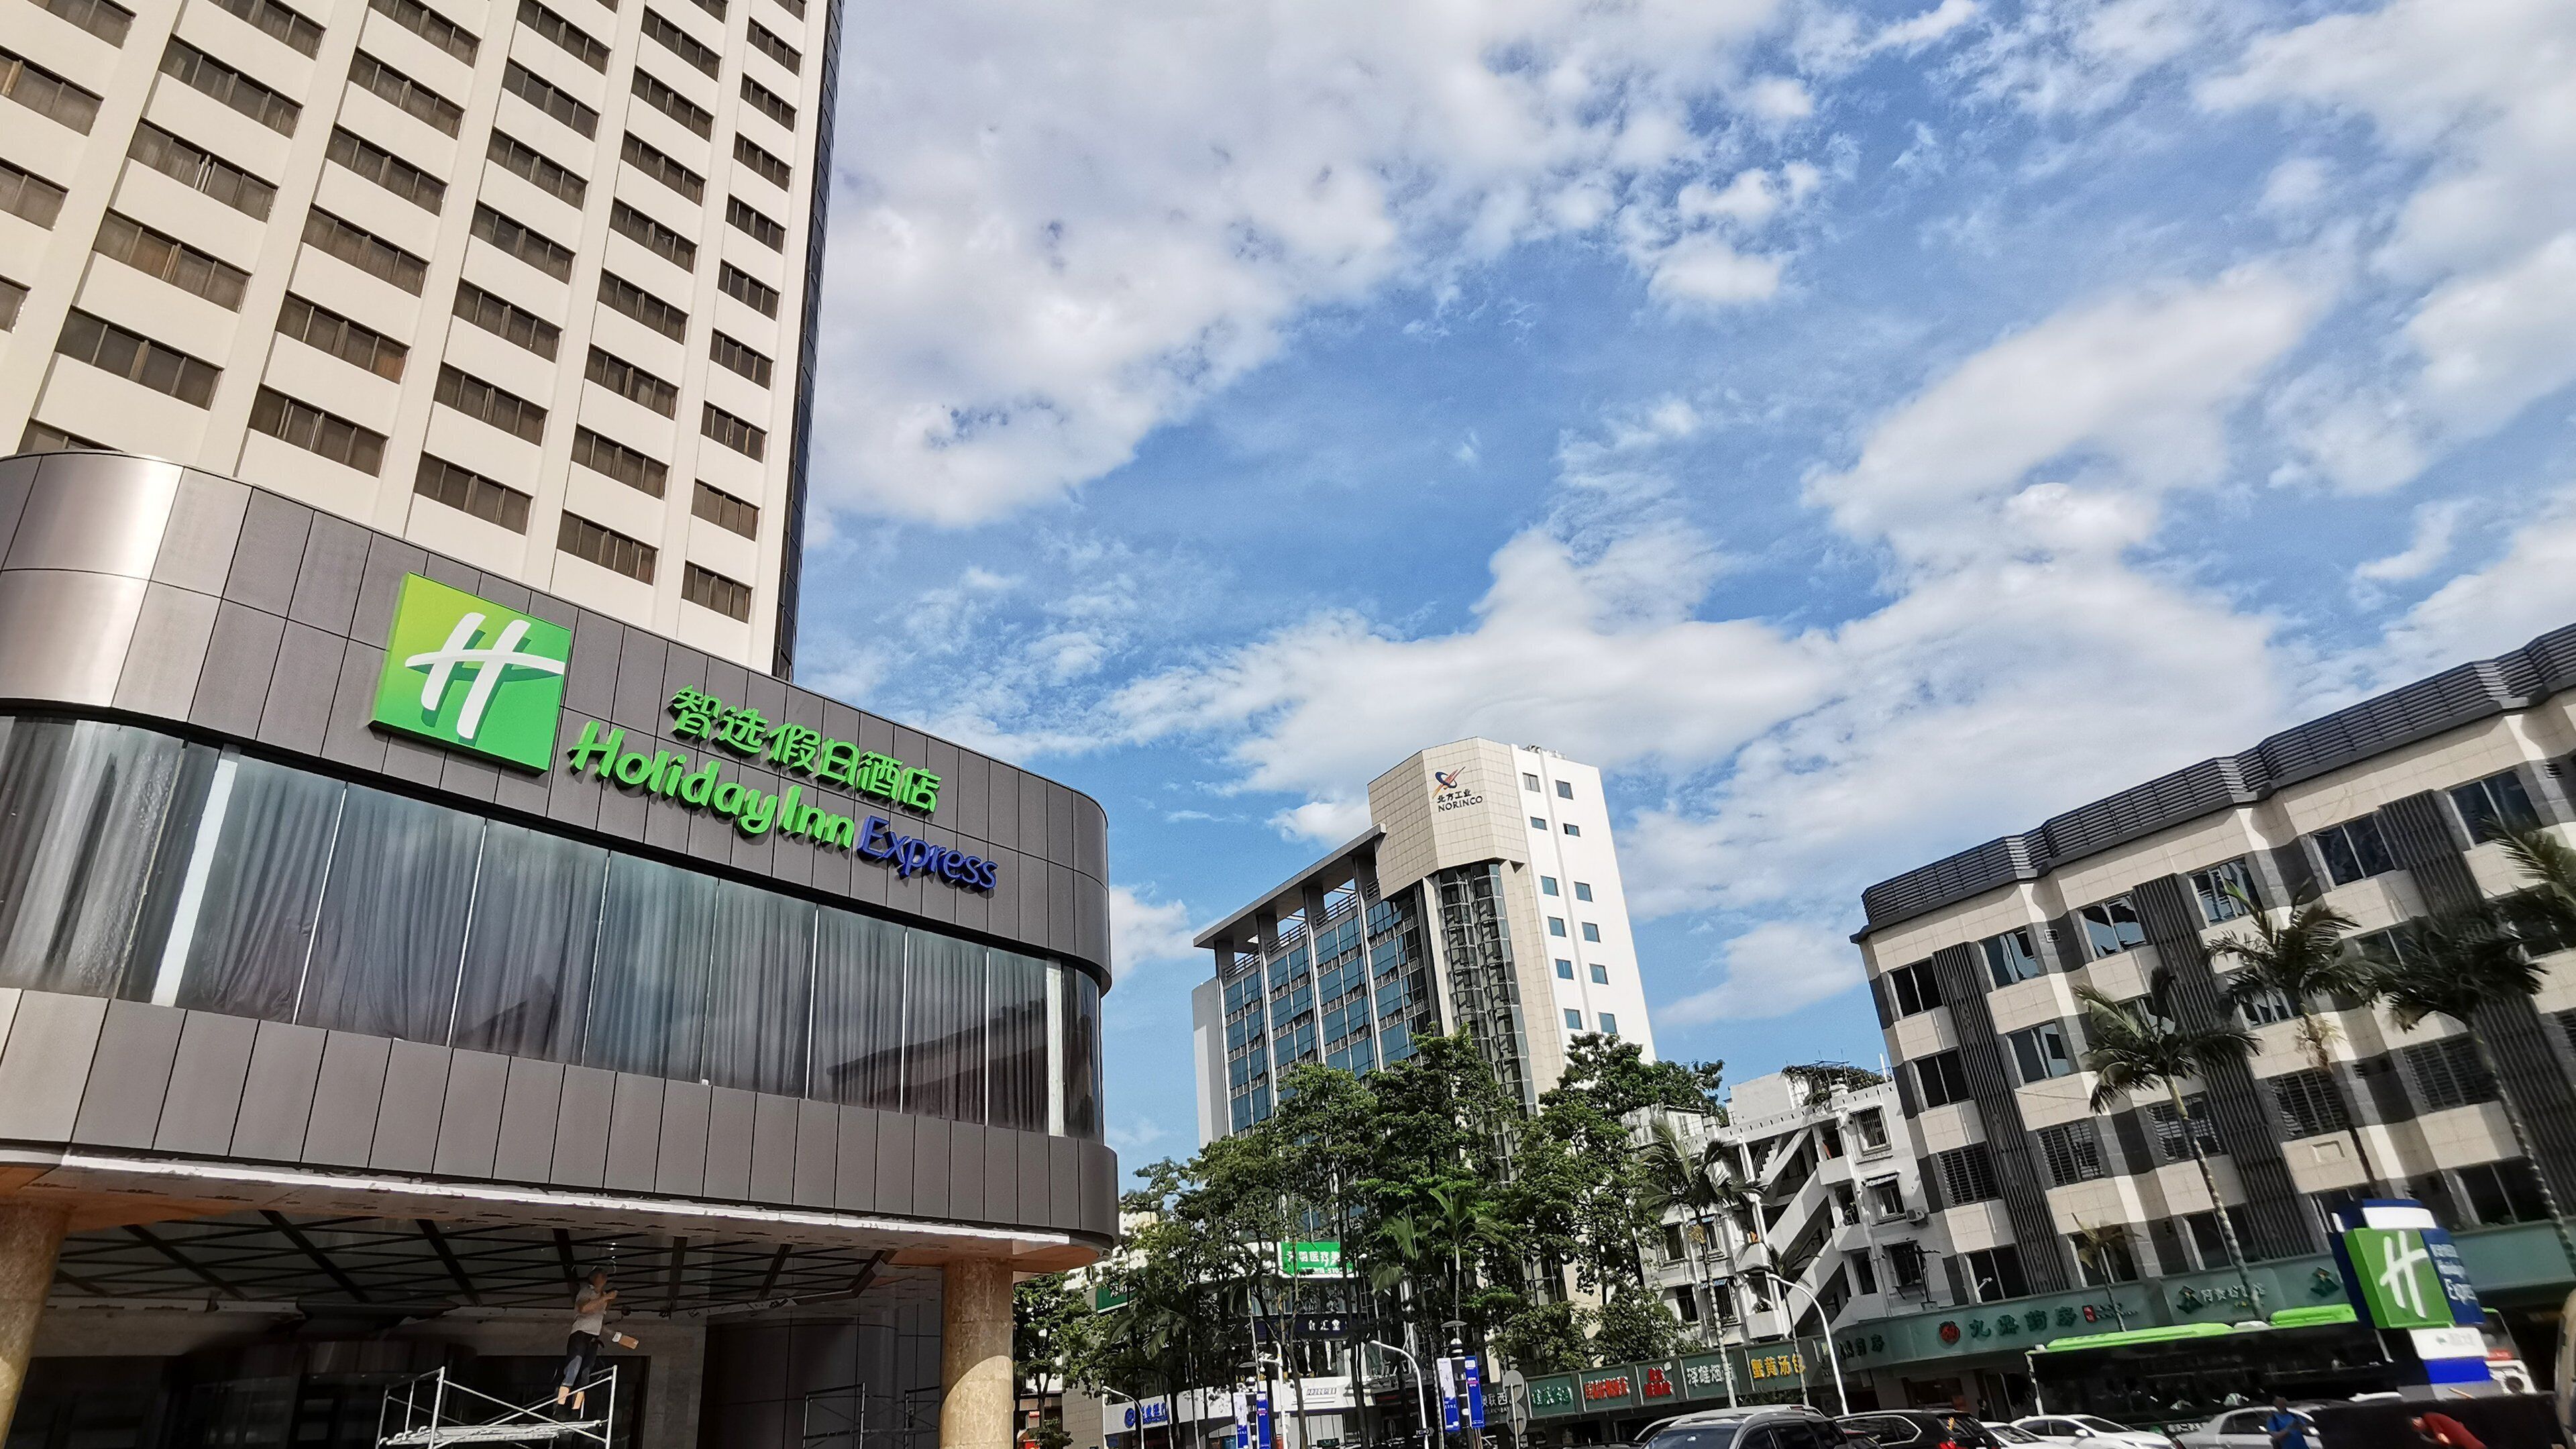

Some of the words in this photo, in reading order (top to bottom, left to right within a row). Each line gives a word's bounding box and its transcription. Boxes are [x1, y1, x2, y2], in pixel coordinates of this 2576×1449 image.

[669, 684, 941, 814] 智选假日酒店
[568, 720, 779, 836] Holiday
[778, 784, 855, 851] Inn
[857, 815, 998, 890] Express
[1437, 788, 1472, 804] 北方工业
[1438, 795, 1483, 812] NORINCO
